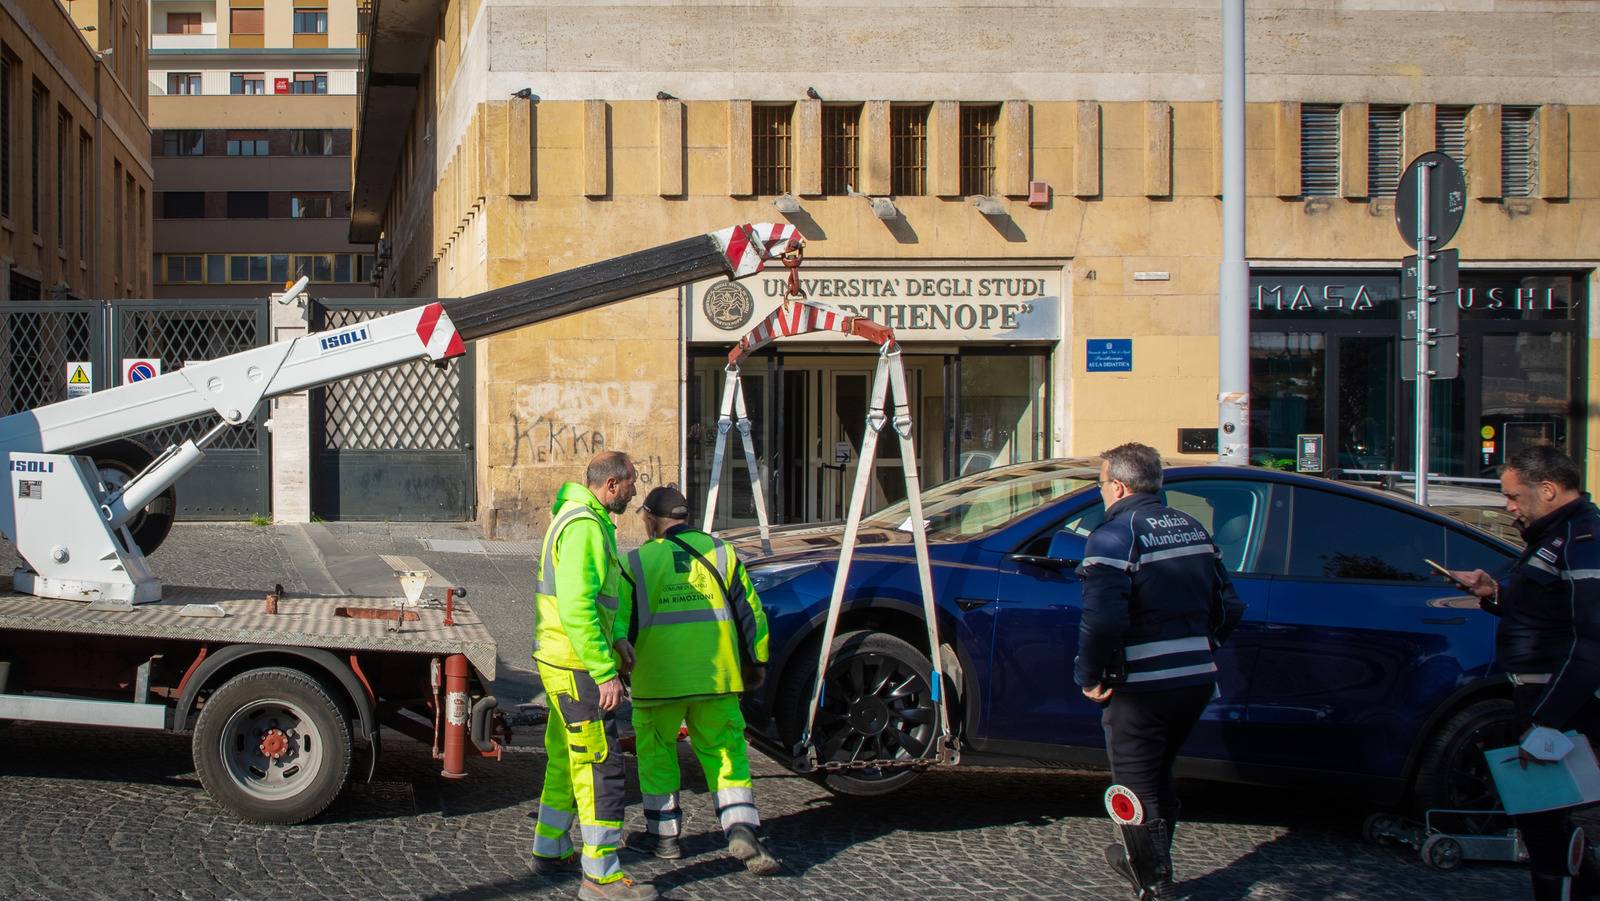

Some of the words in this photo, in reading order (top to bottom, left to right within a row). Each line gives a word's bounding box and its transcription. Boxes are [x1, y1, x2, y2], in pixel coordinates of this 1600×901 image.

[1085, 270, 1097, 280] 41
[906, 278, 973, 297] DEGLI
[978, 278, 1045, 297] STUDI
[1257, 285, 1376, 310] MASA
[1457, 286, 1554, 310] USHI
[321, 328, 368, 350] ISOLI
[9, 460, 54, 473] ISOLI
[1146, 514, 1188, 528] Polizia
[1140, 528, 1206, 547] Municipale
[672, 594, 714, 602] RIMOZIONI
